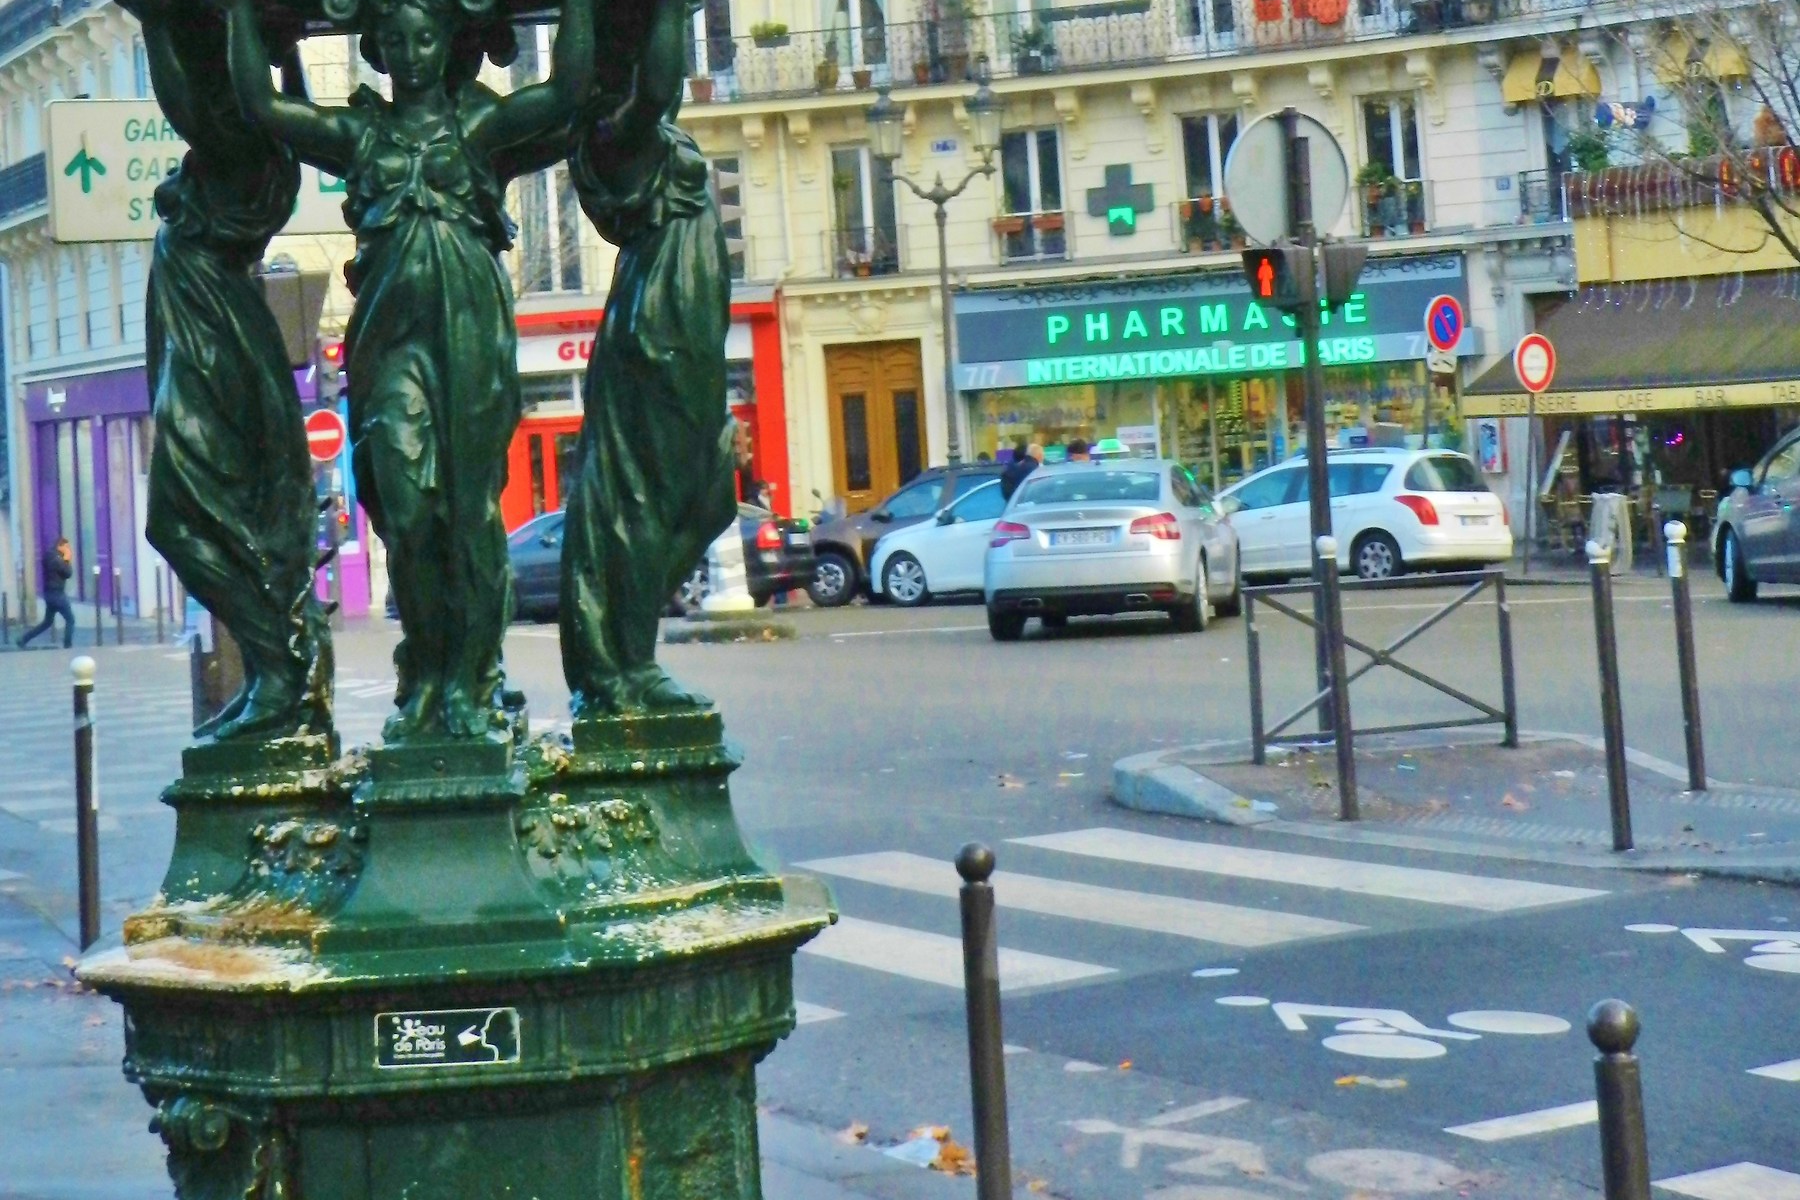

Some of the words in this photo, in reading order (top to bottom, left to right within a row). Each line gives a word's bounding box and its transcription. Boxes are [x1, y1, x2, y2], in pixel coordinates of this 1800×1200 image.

[124, 118, 186, 141] GAR
[1047, 294, 1366, 344] PHARMAIE
[1027, 345, 1247, 384] INTERNATIONALE
[1250, 342, 1288, 369] DE
[1500, 395, 1577, 413] BRASERIE
[1695, 389, 1729, 407] BAR
[416, 1037, 446, 1051] Paris
